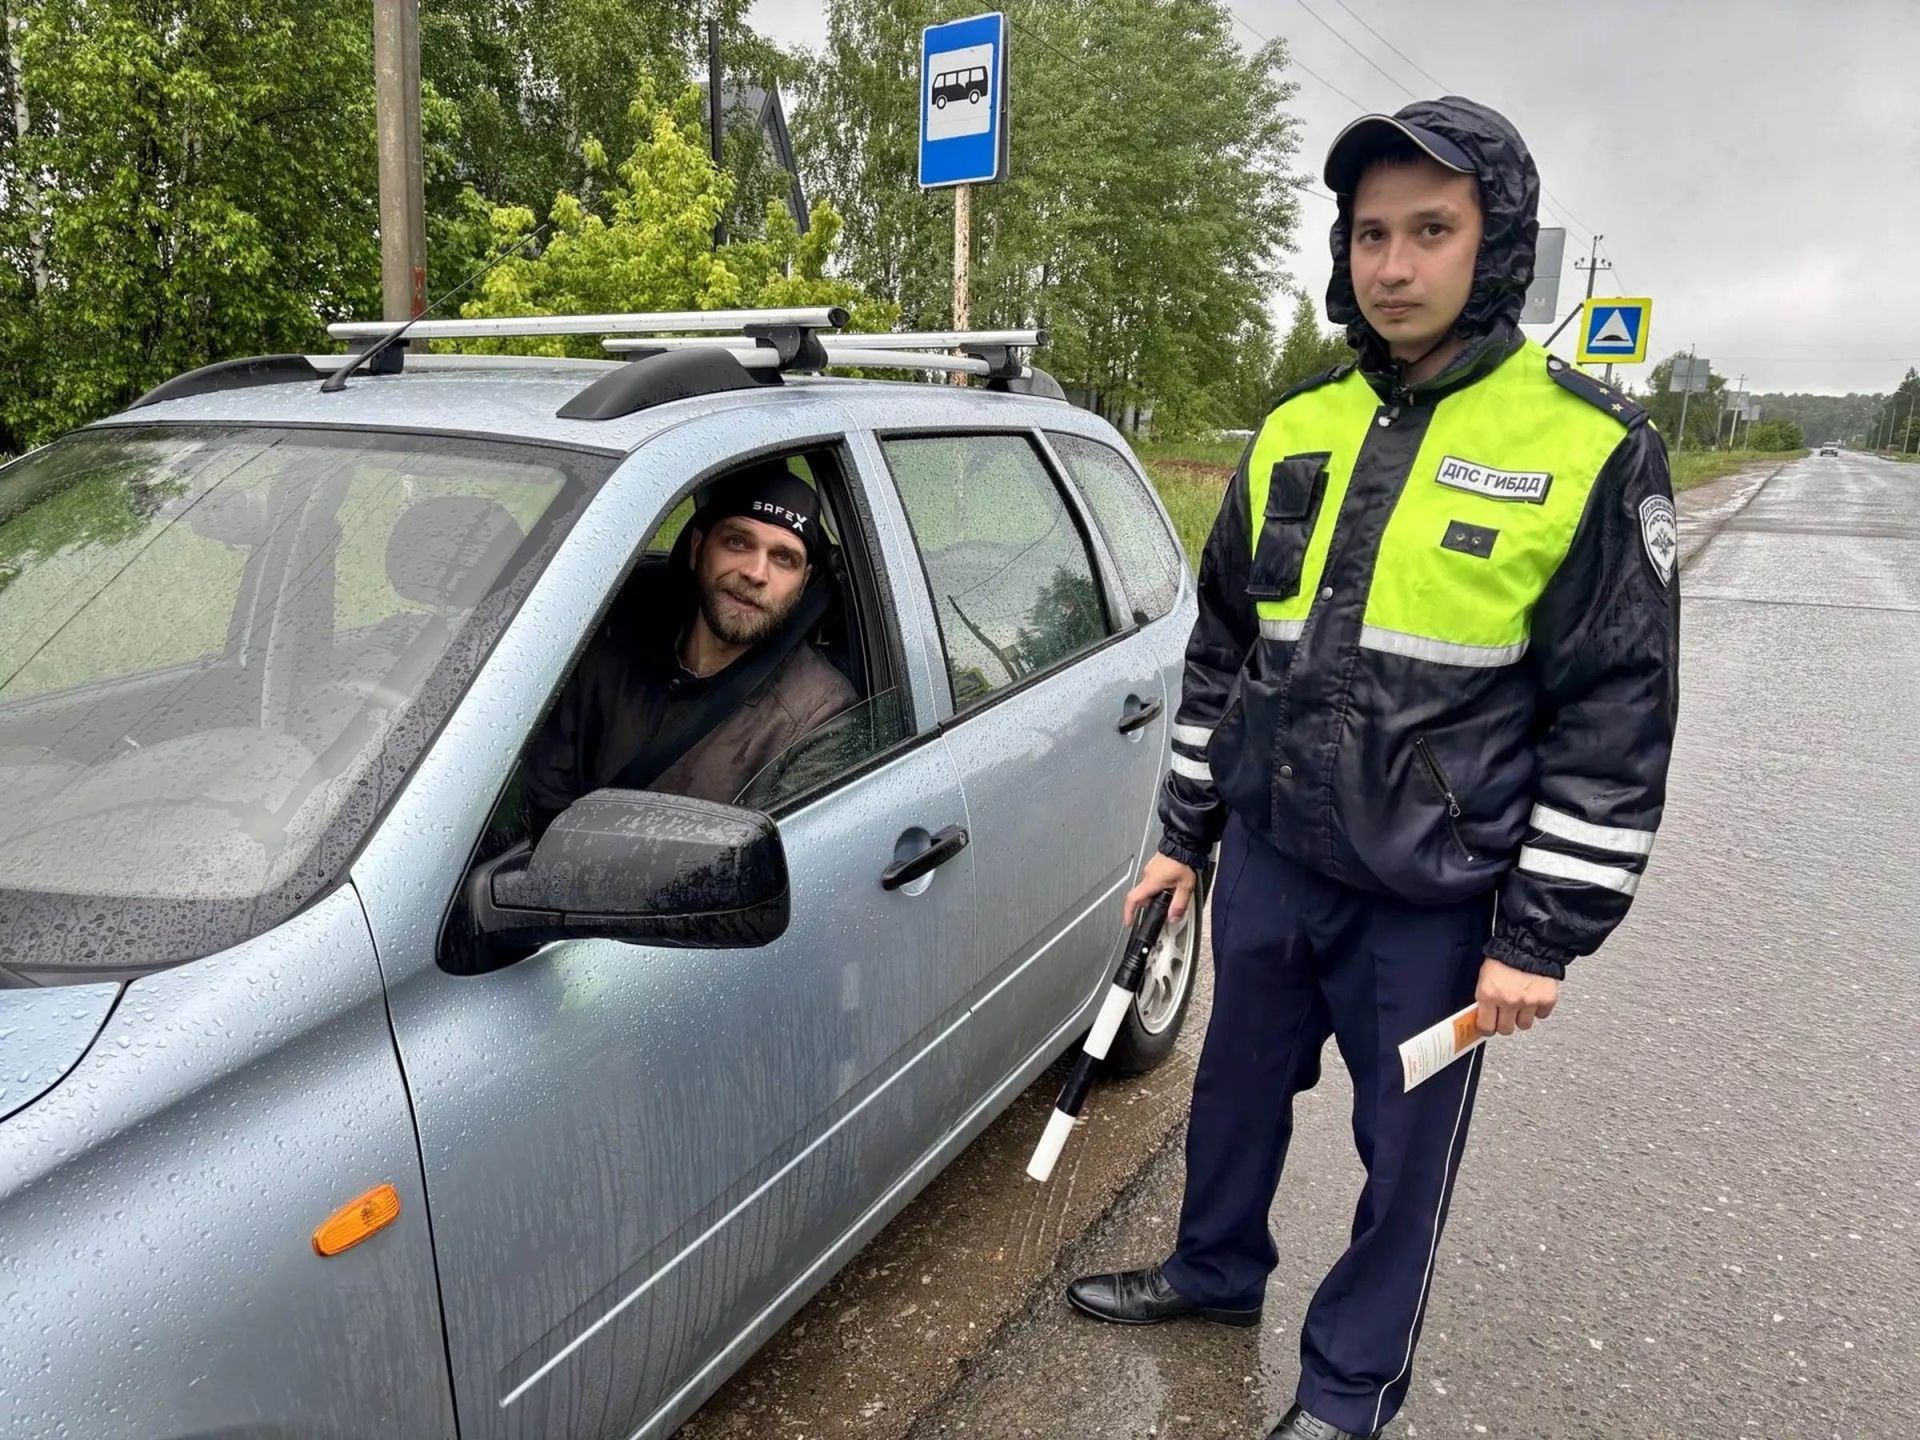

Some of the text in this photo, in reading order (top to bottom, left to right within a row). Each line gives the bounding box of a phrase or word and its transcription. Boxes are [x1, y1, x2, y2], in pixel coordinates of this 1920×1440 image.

[1442, 462, 1541, 493] ДПС ГИБДД
[752, 501, 808, 533] SAFEX
[1645, 500, 1674, 517] ПОЛИЦИ
